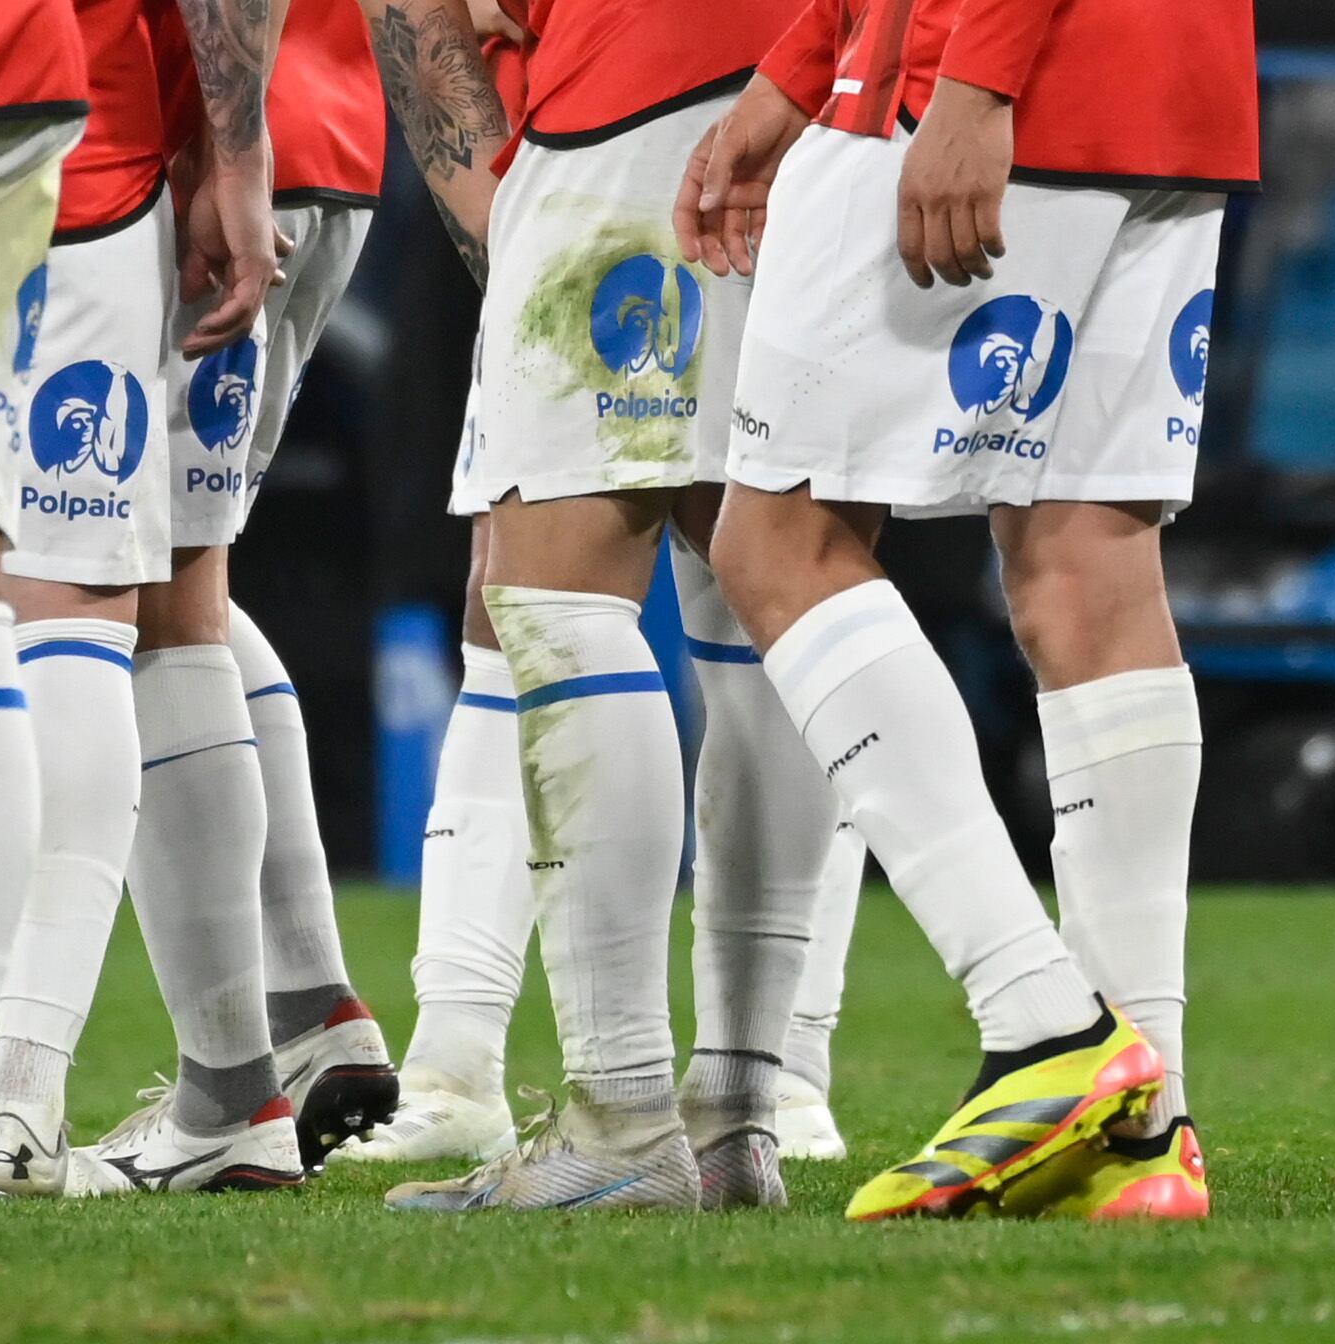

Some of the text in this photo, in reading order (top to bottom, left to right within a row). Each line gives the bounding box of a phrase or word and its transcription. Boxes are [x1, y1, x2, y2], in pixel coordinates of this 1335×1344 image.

[596, 389, 697, 420] Polpaico
[933, 427, 1046, 459] Polpaico
[20, 486, 131, 521] Polpaic
